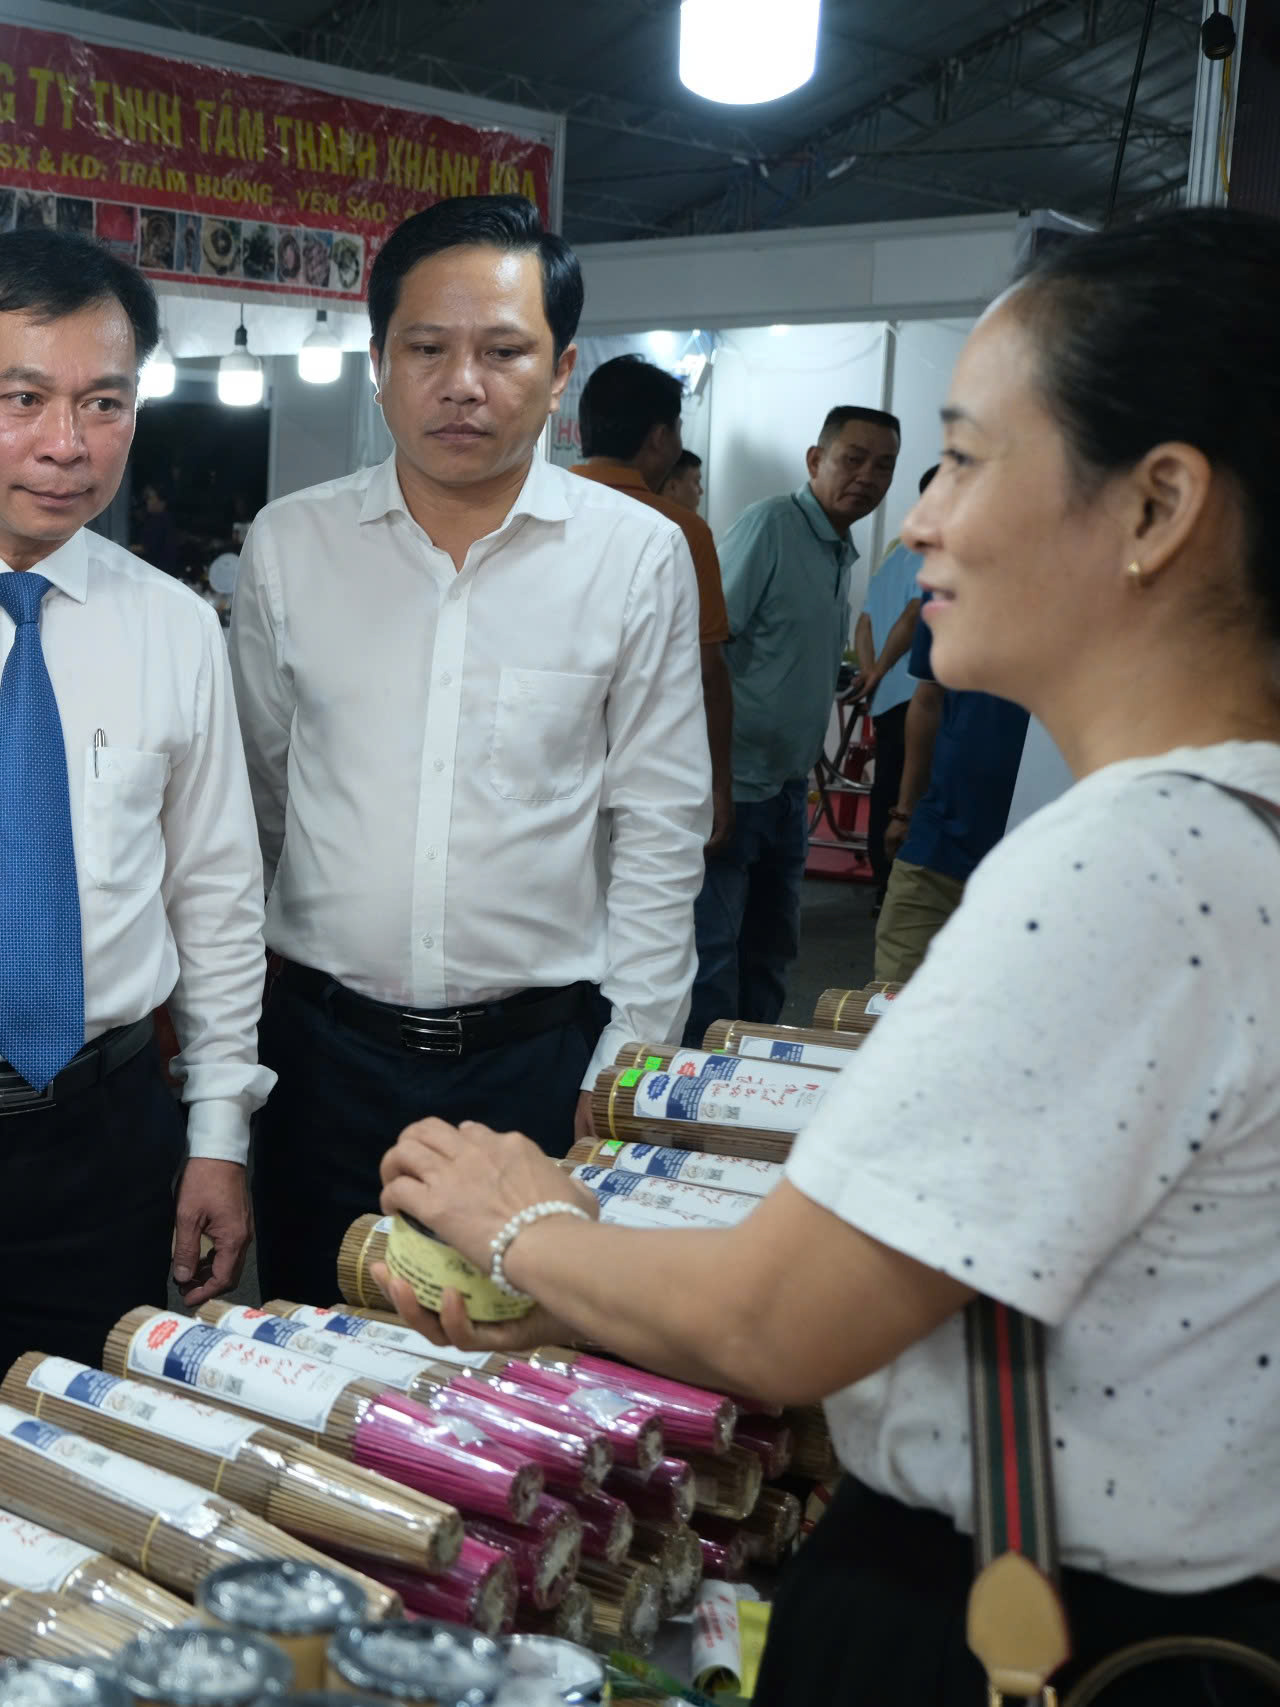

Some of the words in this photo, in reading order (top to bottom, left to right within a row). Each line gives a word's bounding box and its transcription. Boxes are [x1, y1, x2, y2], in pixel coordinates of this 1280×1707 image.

[29, 67, 78, 129] TY
[90, 80, 183, 149] TNHH
[195, 89, 265, 163] TÂM
[274, 115, 377, 181] THANH
[386, 132, 480, 197] KHÁNH
[37, 147, 56, 174] &
